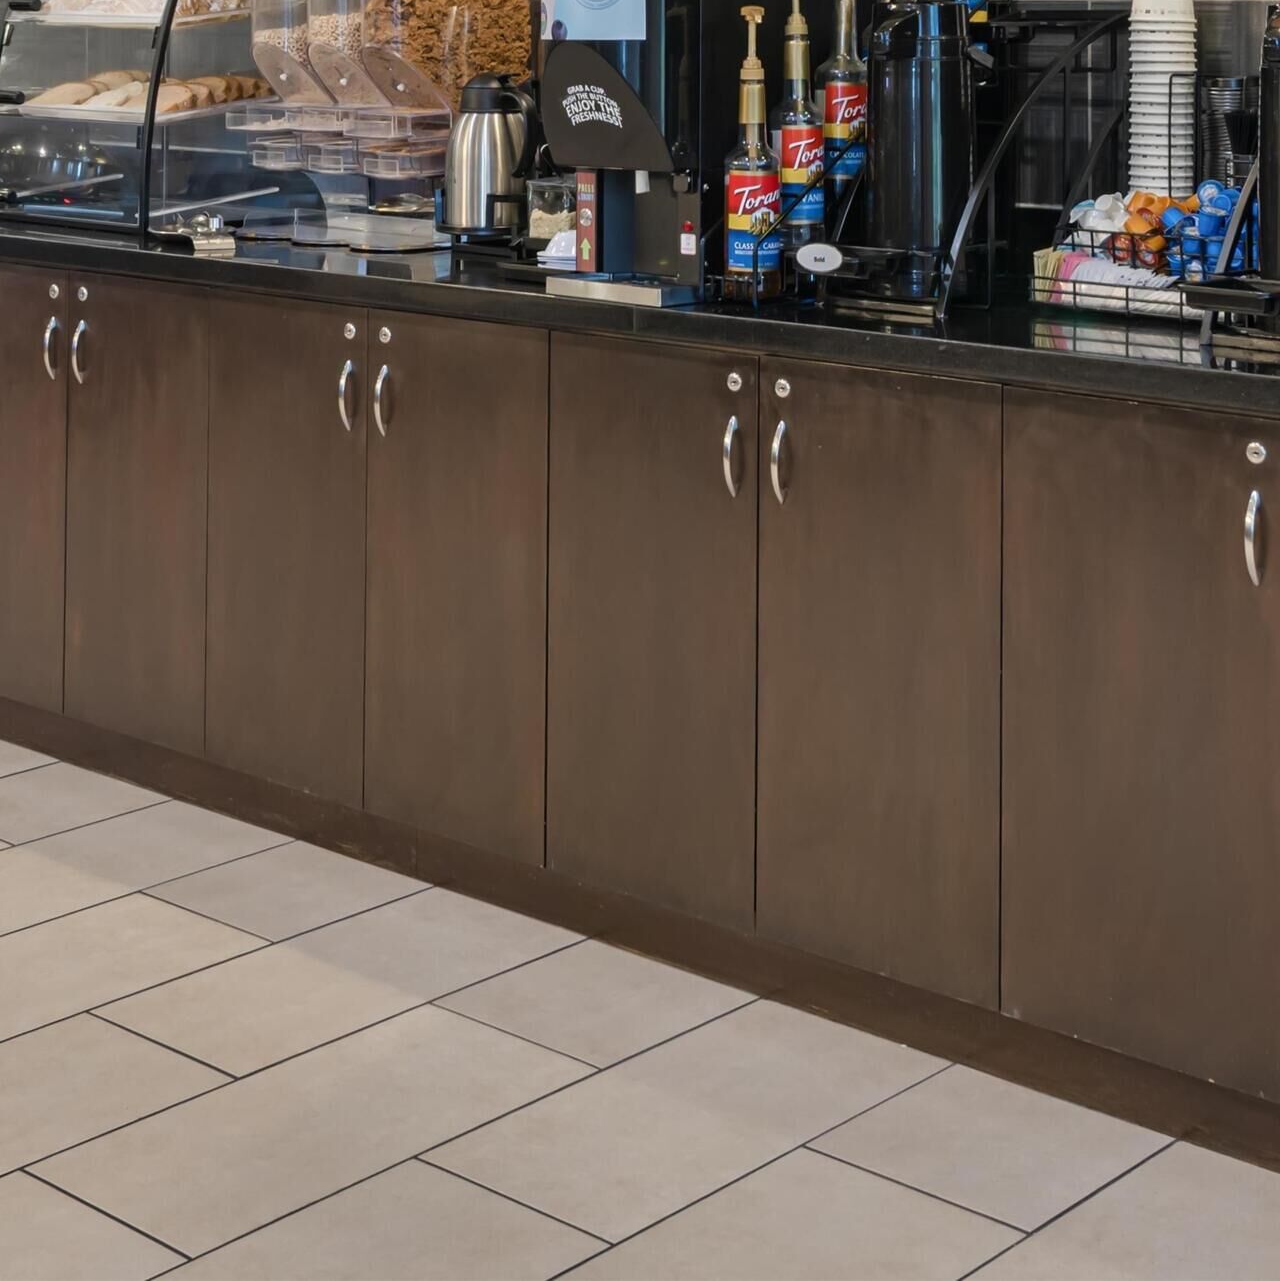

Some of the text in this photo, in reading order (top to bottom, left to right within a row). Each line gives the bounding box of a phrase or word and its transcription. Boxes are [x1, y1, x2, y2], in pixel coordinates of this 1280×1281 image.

[565, 99, 595, 118] ENJOY
[832, 94, 867, 126] Tora
[789, 137, 825, 171] Tora
[734, 184, 782, 217] Toran
